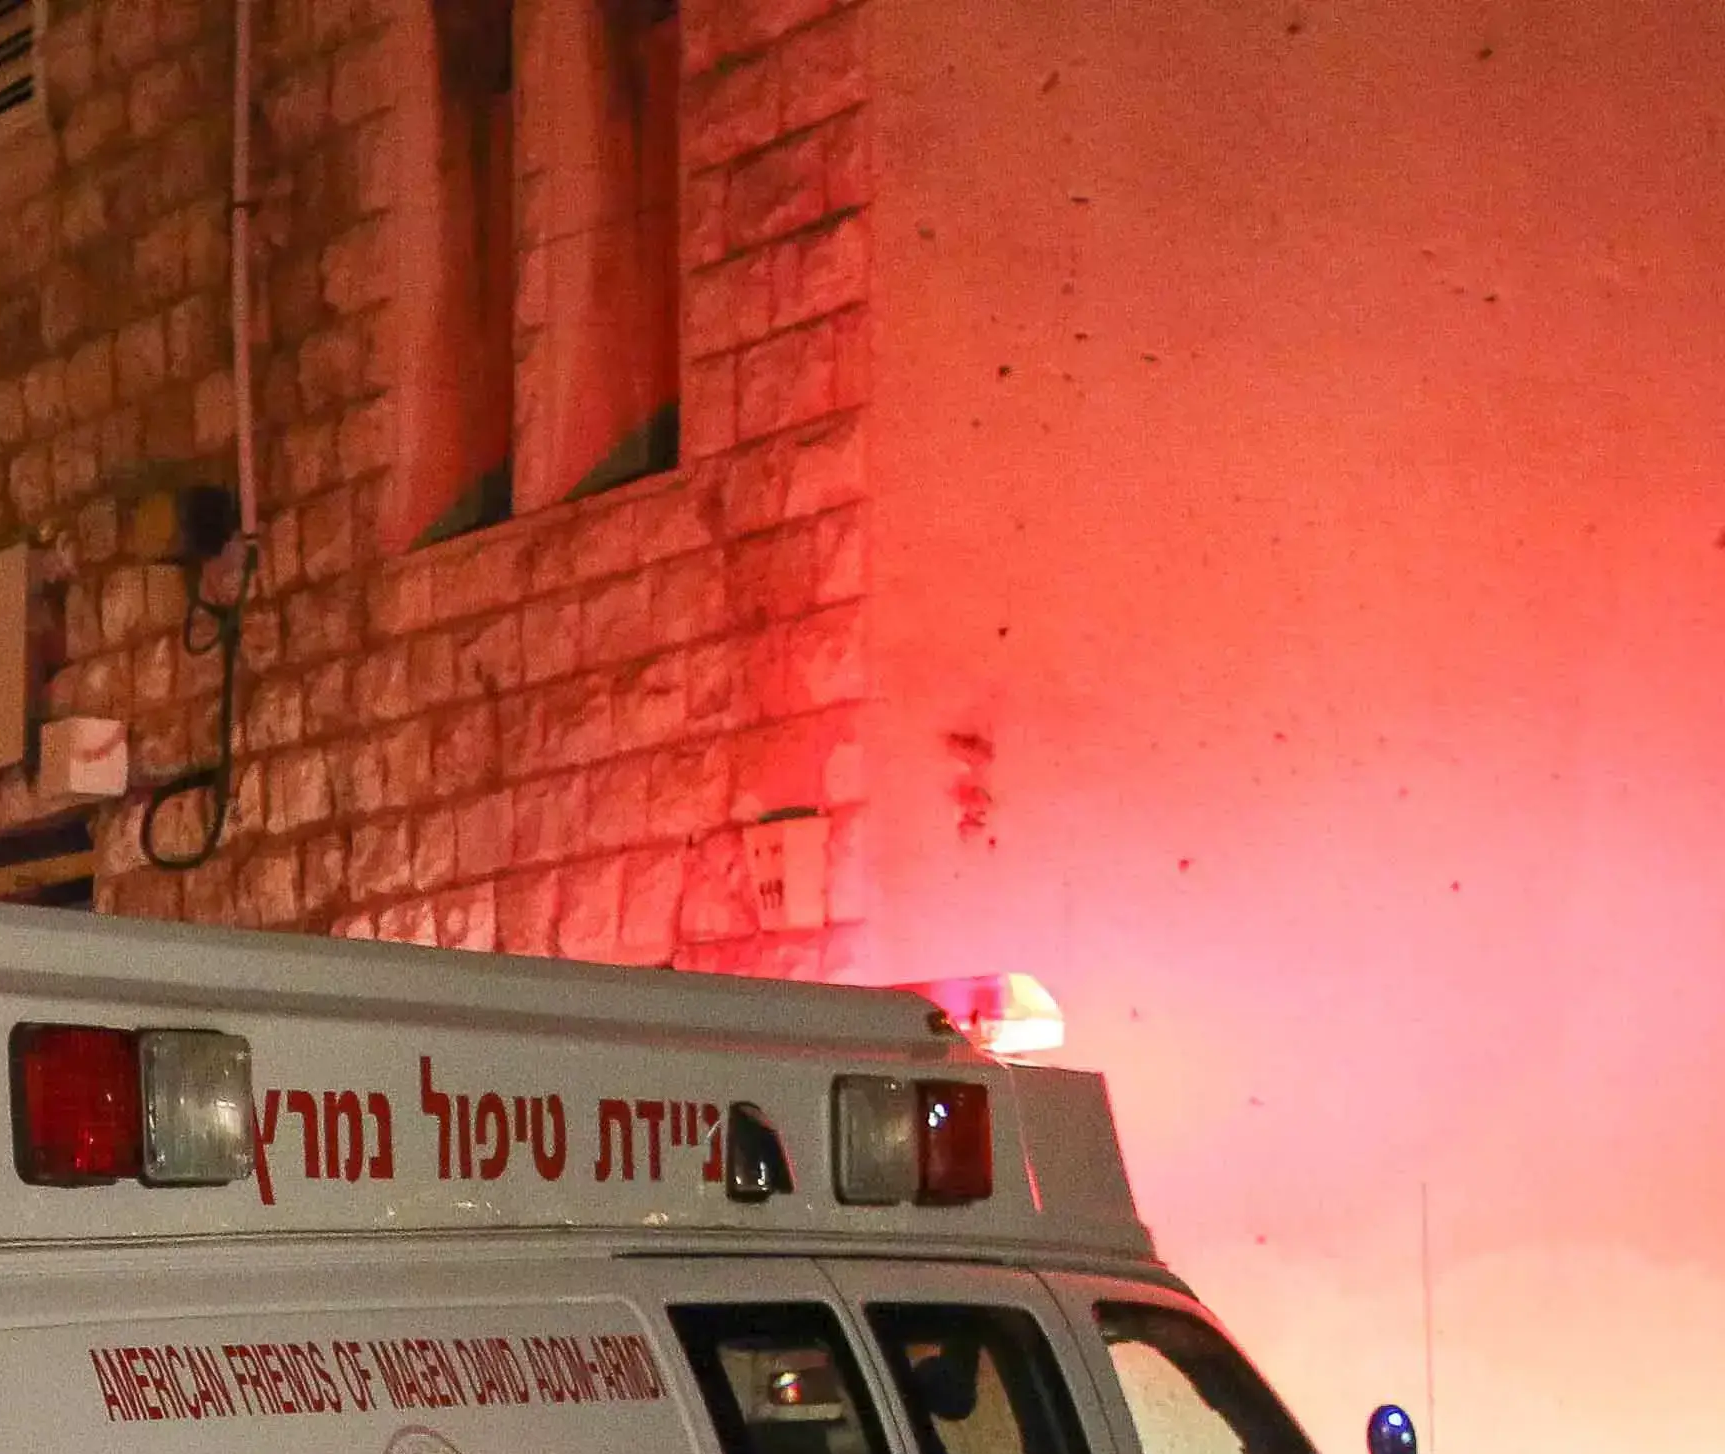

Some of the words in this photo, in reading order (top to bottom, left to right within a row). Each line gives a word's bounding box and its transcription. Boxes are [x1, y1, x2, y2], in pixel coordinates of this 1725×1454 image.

[250, 1088, 395, 1205] נמרץ
[420, 1055, 567, 1182] טיפול
[594, 1098, 723, 1183] ניידת
[88, 1344, 237, 1422] AMERICAN
[221, 1340, 342, 1417] FRIENDS
[333, 1339, 377, 1412] OF
[368, 1337, 467, 1408] MAGEN
[453, 1336, 530, 1406] DAVID
